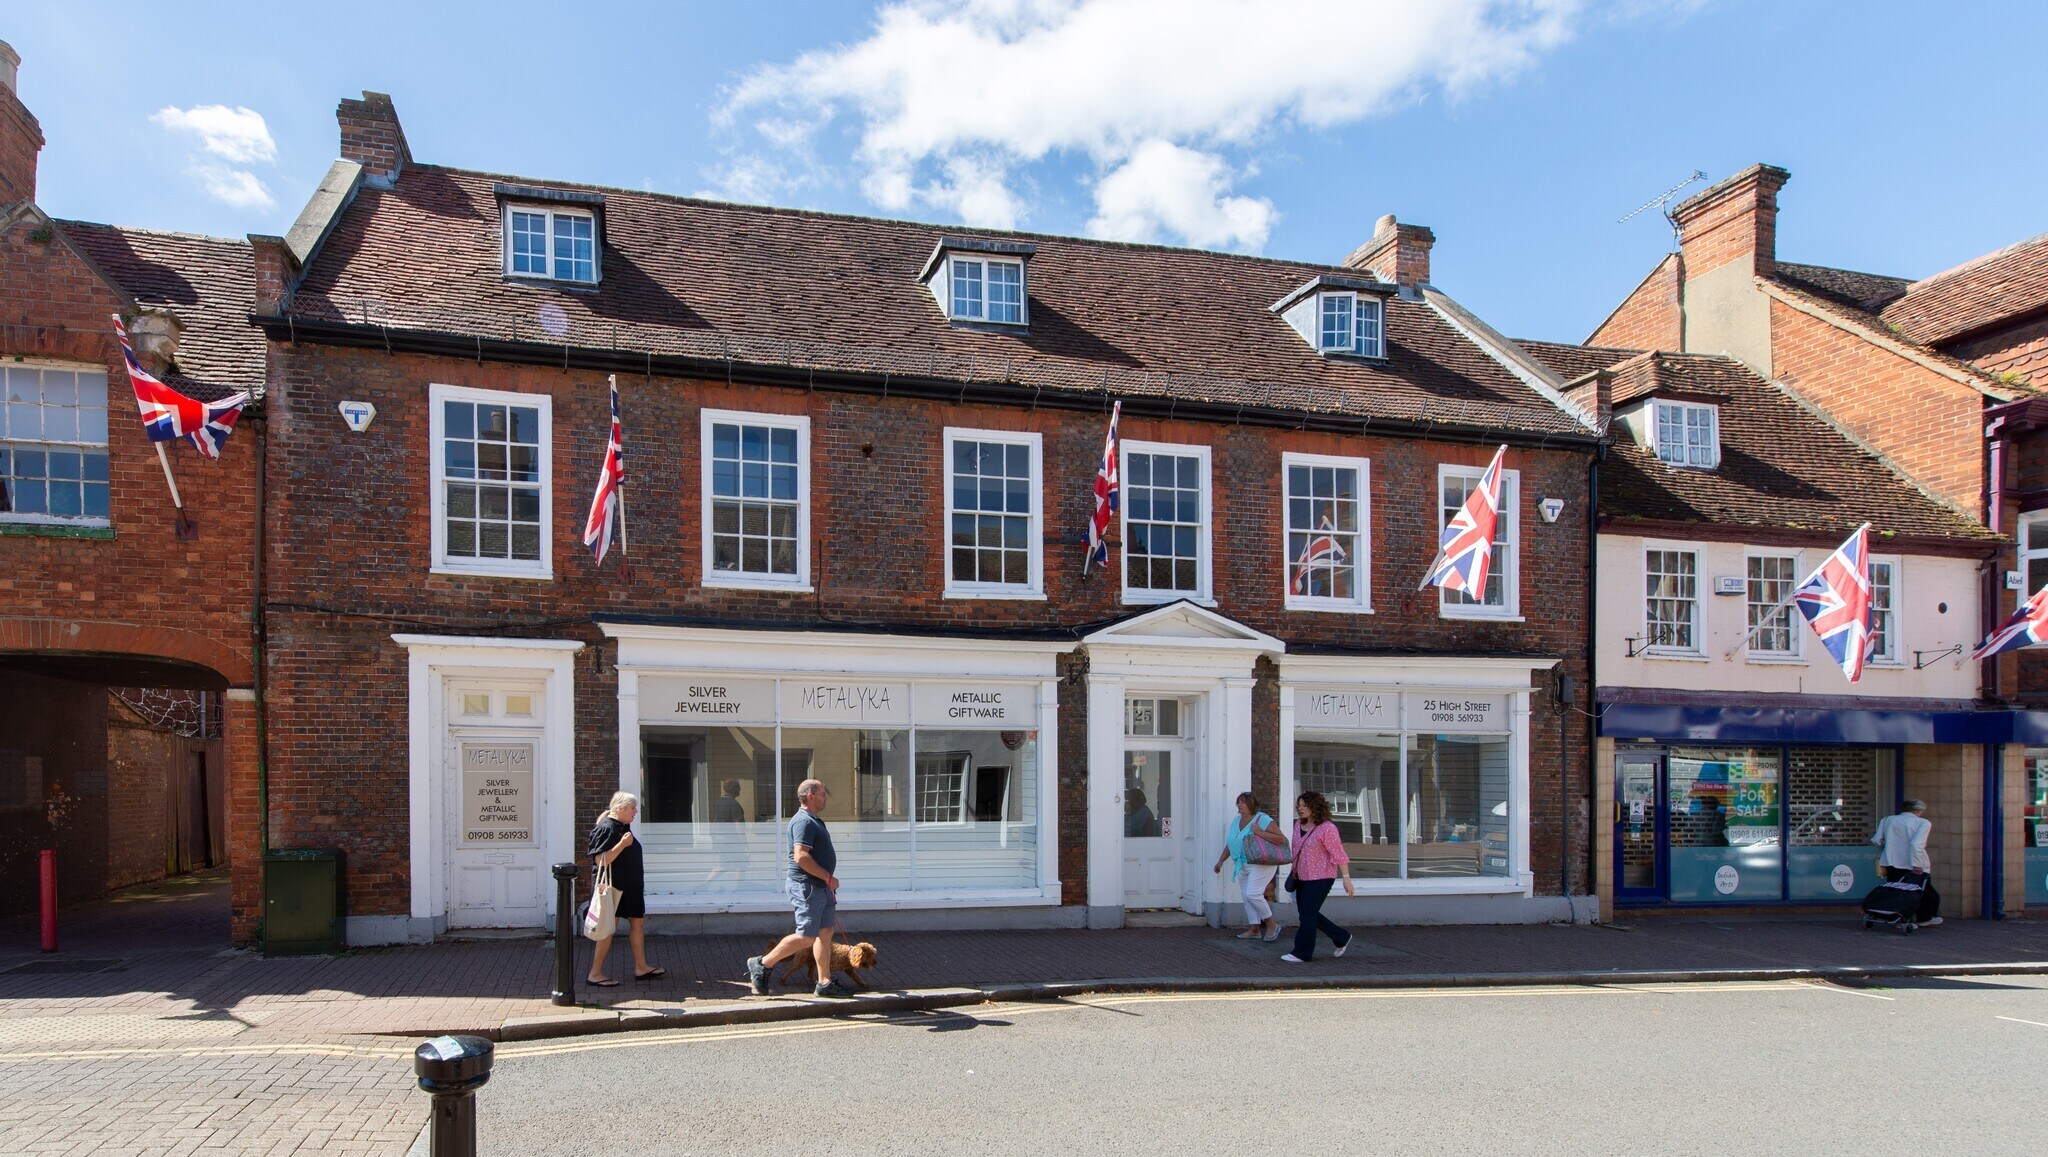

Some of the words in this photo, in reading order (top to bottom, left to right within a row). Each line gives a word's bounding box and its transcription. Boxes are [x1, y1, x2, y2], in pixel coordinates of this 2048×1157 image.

[688, 686, 727, 698] SILVER
[951, 692, 1002, 704] METALLIC
[674, 702, 741, 714] JEWELLERY
[802, 686, 891, 721] METALYKA
[1423, 700, 1436, 711] 25
[948, 706, 1005, 718] GIFTWARE
[1135, 710, 1152, 722] 25
[1310, 694, 1383, 727] METALYKA
[1431, 713, 1454, 722] 01908
[1457, 714, 1484, 722] 561933
[468, 749, 528, 771] METALYKA
[486, 779, 510, 787] SILVER
[477, 788, 519, 796] JEWELLERY
[1740, 790, 1766, 801] FOR
[481, 805, 516, 813] METALLIC
[1736, 804, 1769, 817] SALE
[479, 814, 518, 822] GIFTWARE
[468, 831, 494, 840] 01908
[498, 831, 528, 840] 561933
